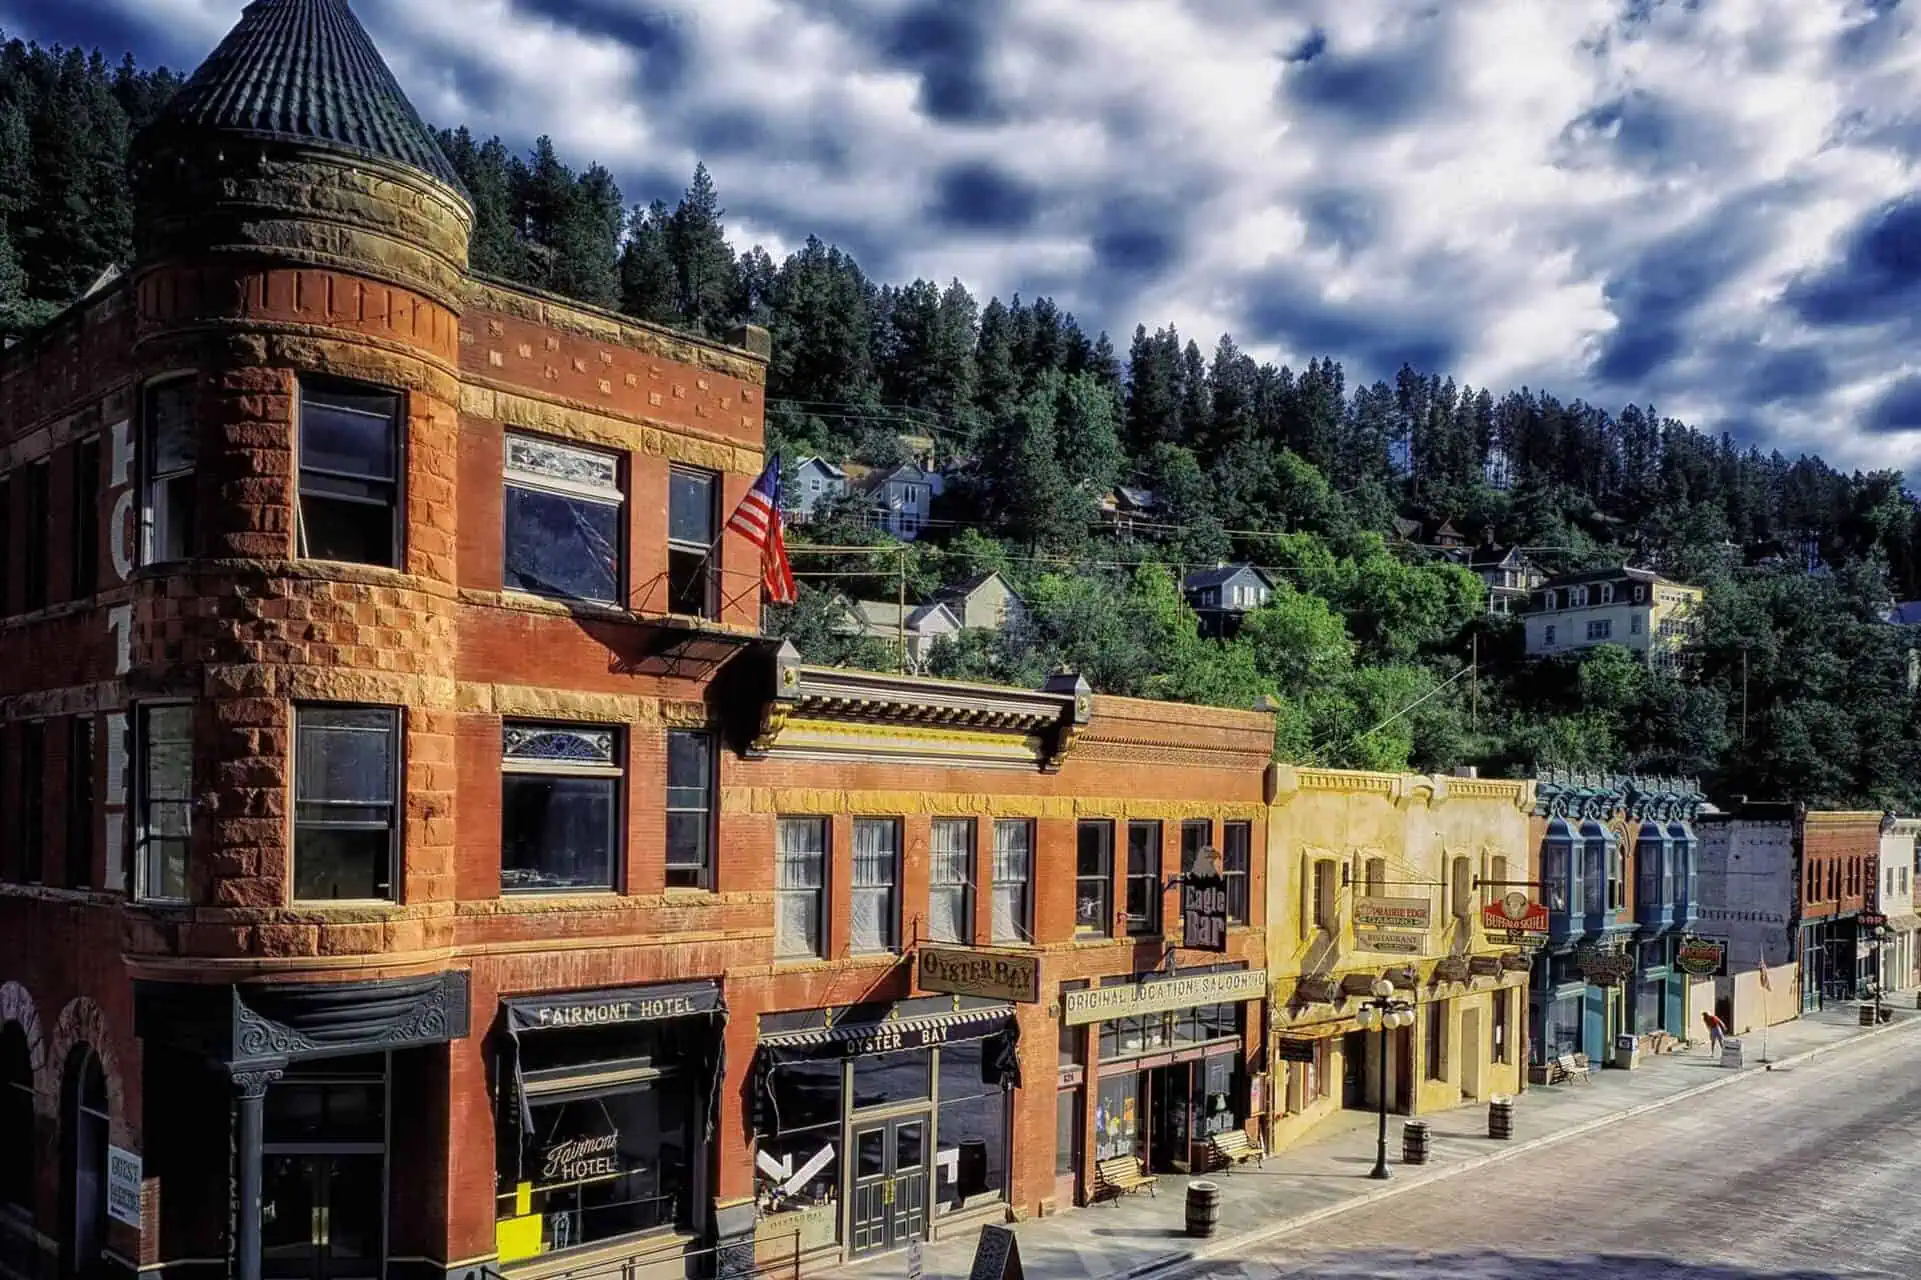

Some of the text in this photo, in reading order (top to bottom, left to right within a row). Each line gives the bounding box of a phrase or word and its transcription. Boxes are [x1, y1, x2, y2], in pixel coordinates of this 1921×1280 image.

[1185, 884, 1226, 917] Eagle
[1185, 914, 1226, 947] Bar
[924, 951, 1033, 988] OYSTER BAY
[539, 997, 696, 1025] FAIRMONT HOTEL
[1067, 990, 1125, 1011] ORIGINAL
[846, 1026, 948, 1055] OYSTER BAY
[544, 1133, 618, 1177] Fairmont
[562, 1156, 616, 1180] HOTEL
